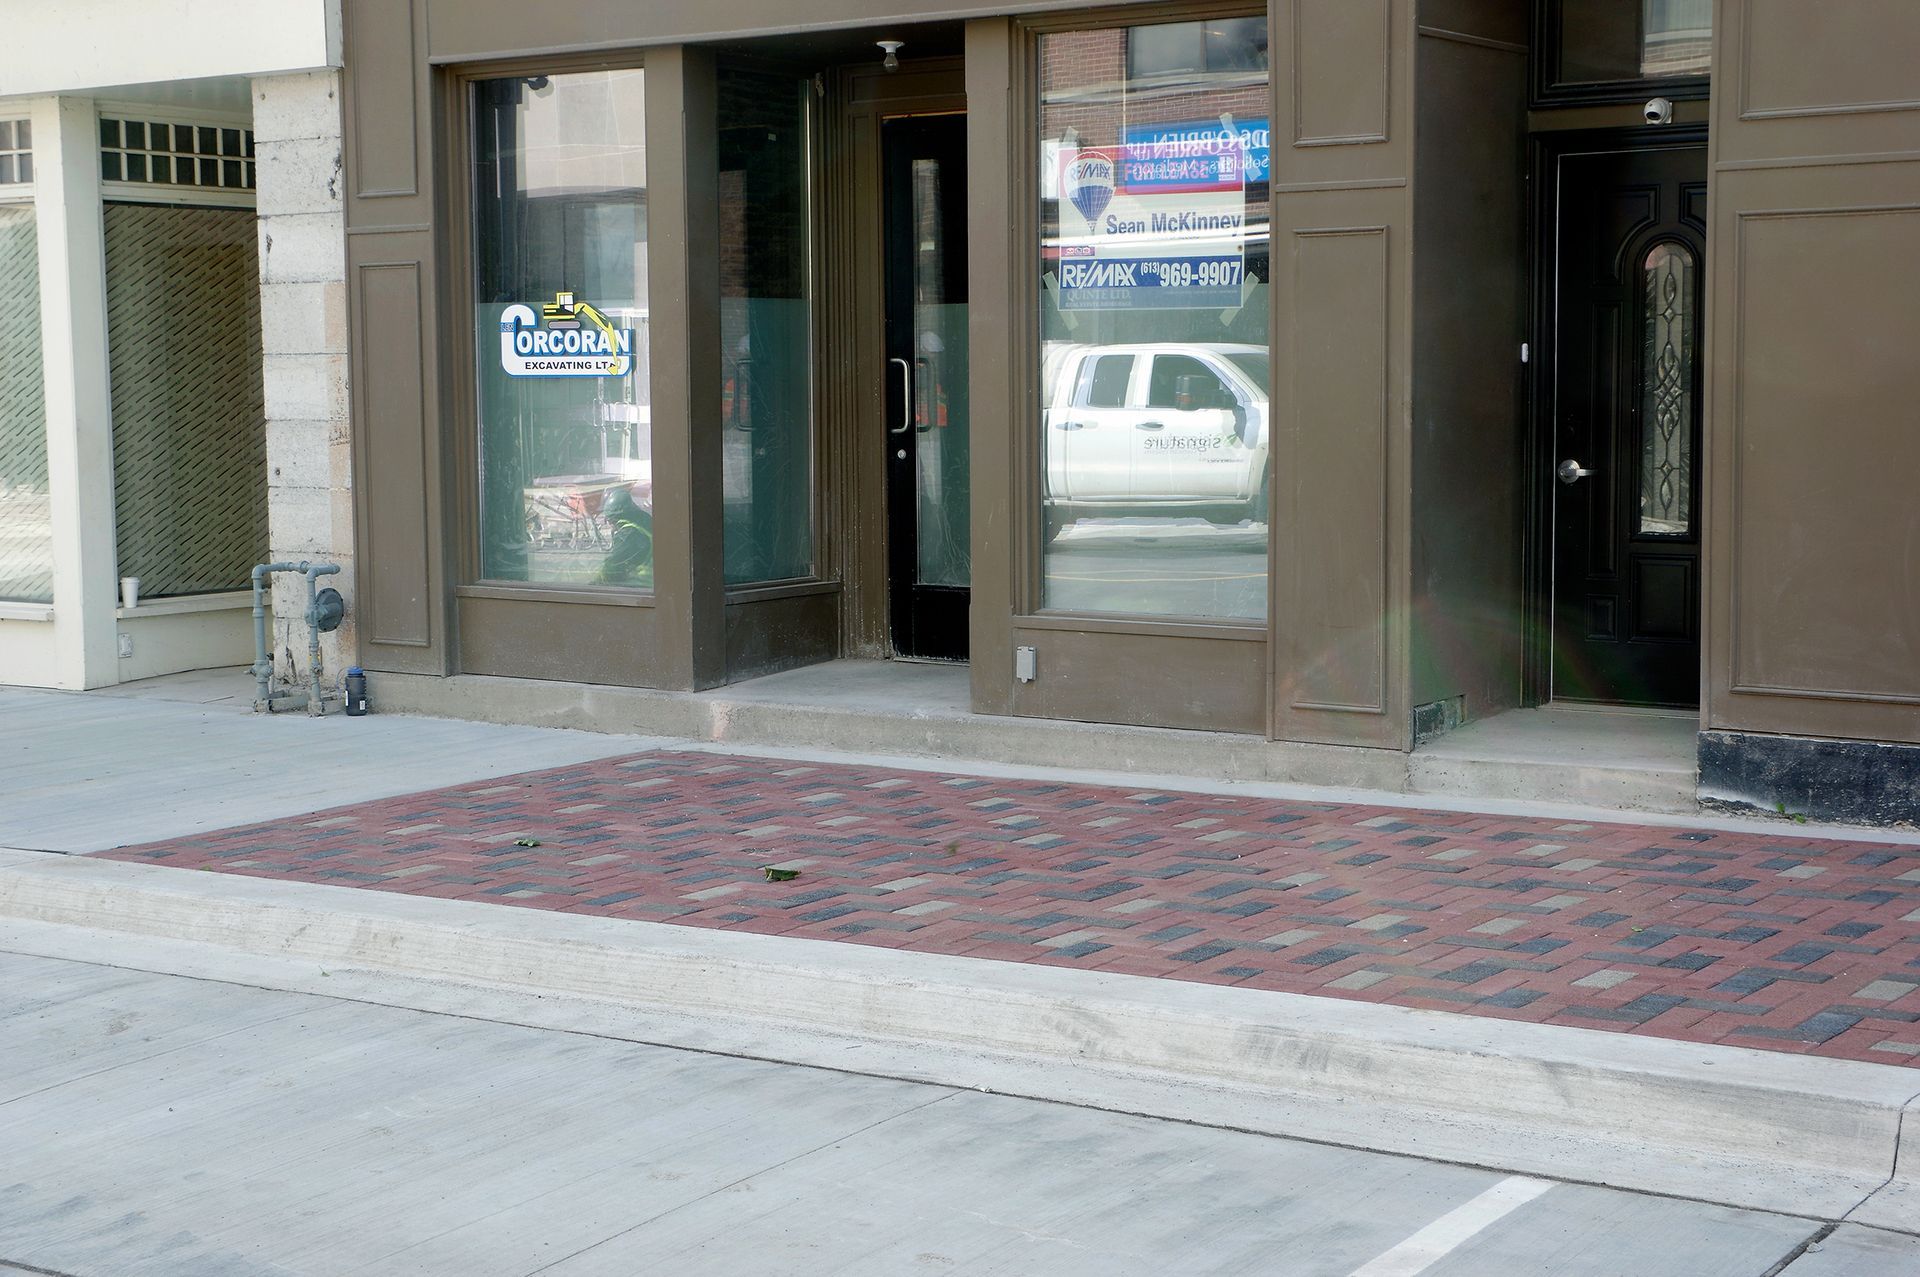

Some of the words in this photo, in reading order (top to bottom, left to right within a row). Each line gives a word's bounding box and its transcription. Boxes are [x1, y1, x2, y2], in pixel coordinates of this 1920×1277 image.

[1106, 214, 1146, 235] Sean
[1151, 212, 1242, 236] McKinney
[1062, 260, 1137, 289] RE/MAX
[1160, 261, 1241, 287] 969-9907
[1067, 289, 1108, 301] QUINTE
[500, 304, 631, 366] CORCORAN
[525, 361, 592, 370] EXCAVATING
